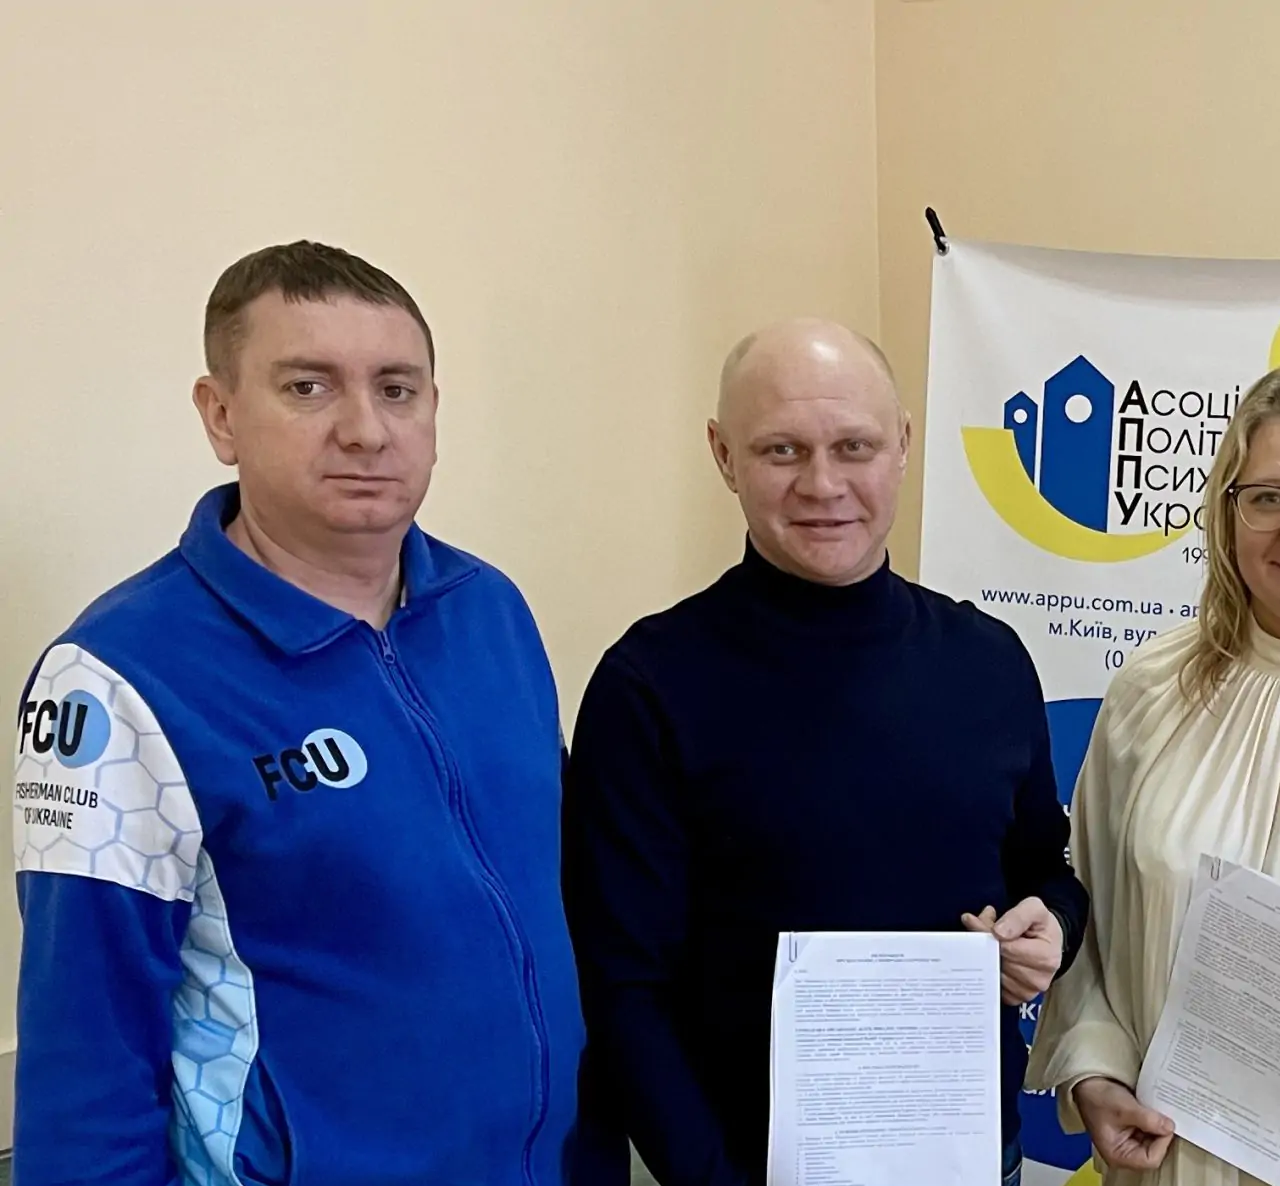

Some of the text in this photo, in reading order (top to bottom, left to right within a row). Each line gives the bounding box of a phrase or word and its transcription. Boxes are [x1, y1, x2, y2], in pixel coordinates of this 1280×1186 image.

[981, 588, 1163, 615] www.appu.com.ua
[1048, 618, 1117, 643] м.Київ,
[18, 698, 88, 757] FCU
[252, 736, 350, 801] FCU
[15, 782, 98, 808] FISHERMAN CLUB
[32, 808, 74, 830] UKRAINE
